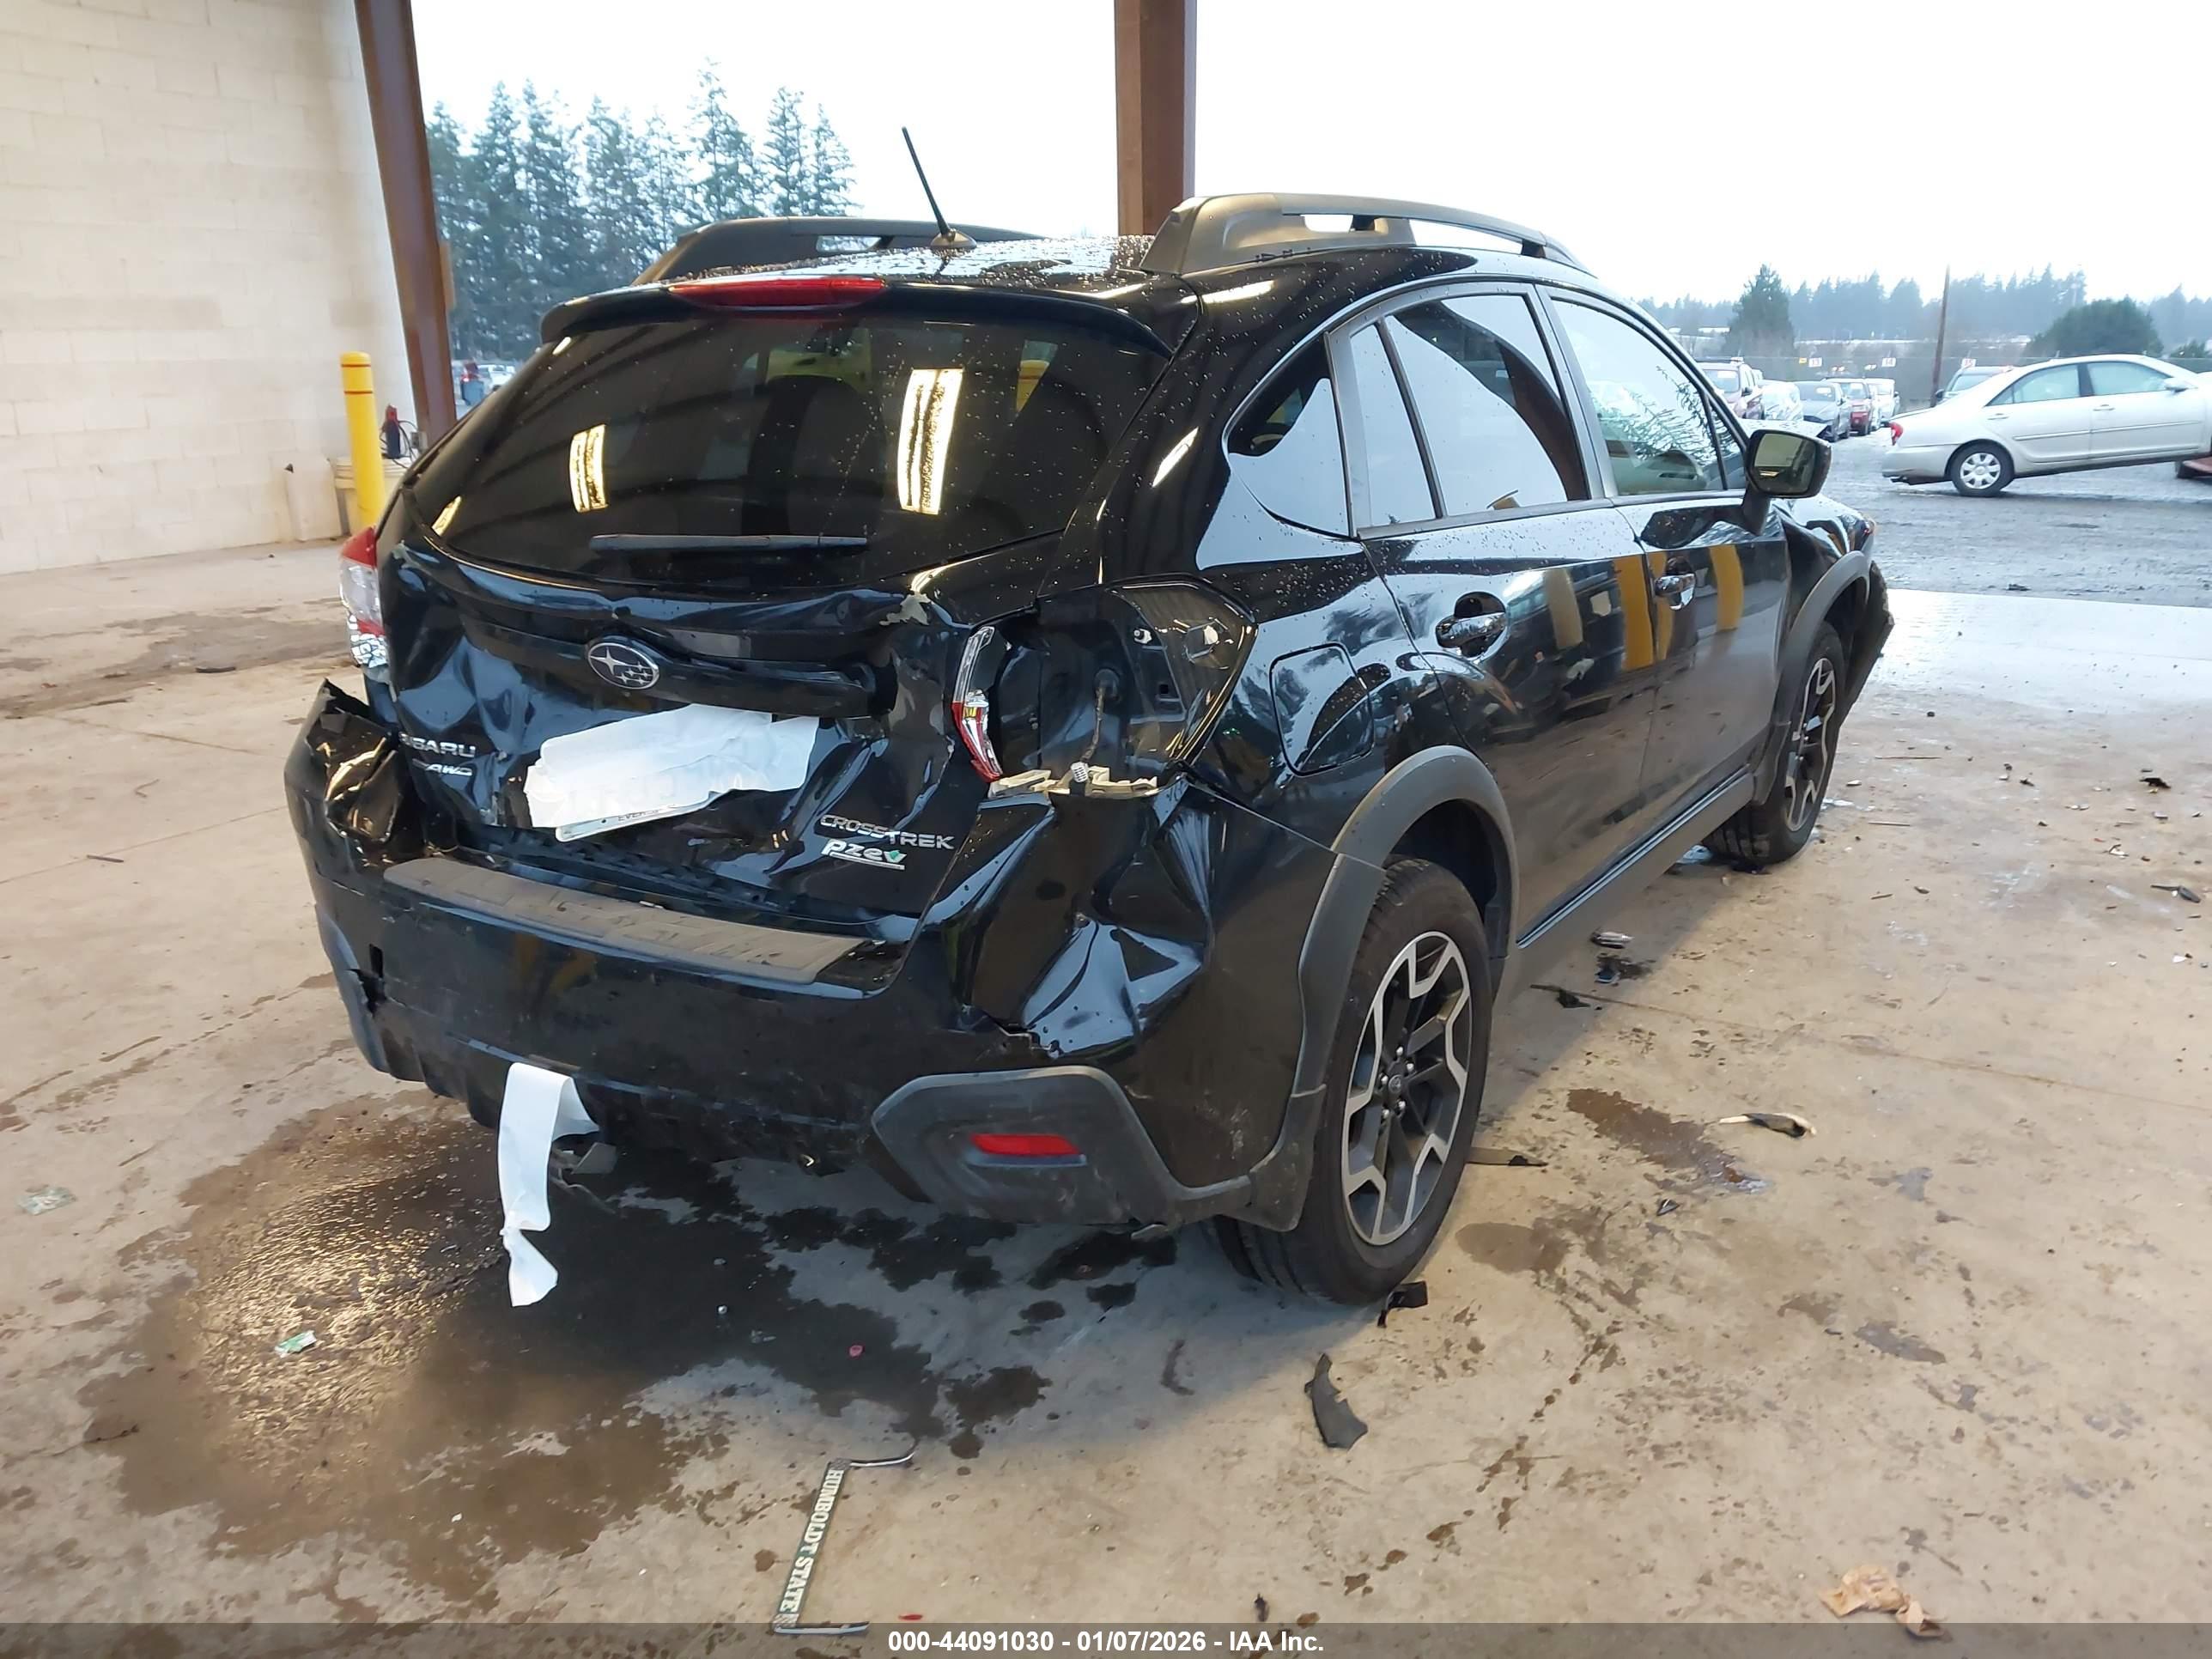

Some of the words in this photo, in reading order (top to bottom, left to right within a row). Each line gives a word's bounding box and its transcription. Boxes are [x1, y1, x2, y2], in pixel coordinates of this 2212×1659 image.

[820, 814, 955, 850] CROSSTREK
[800, 1469, 845, 1555] HUMBOLDT
[779, 1556, 815, 1613] STATE
